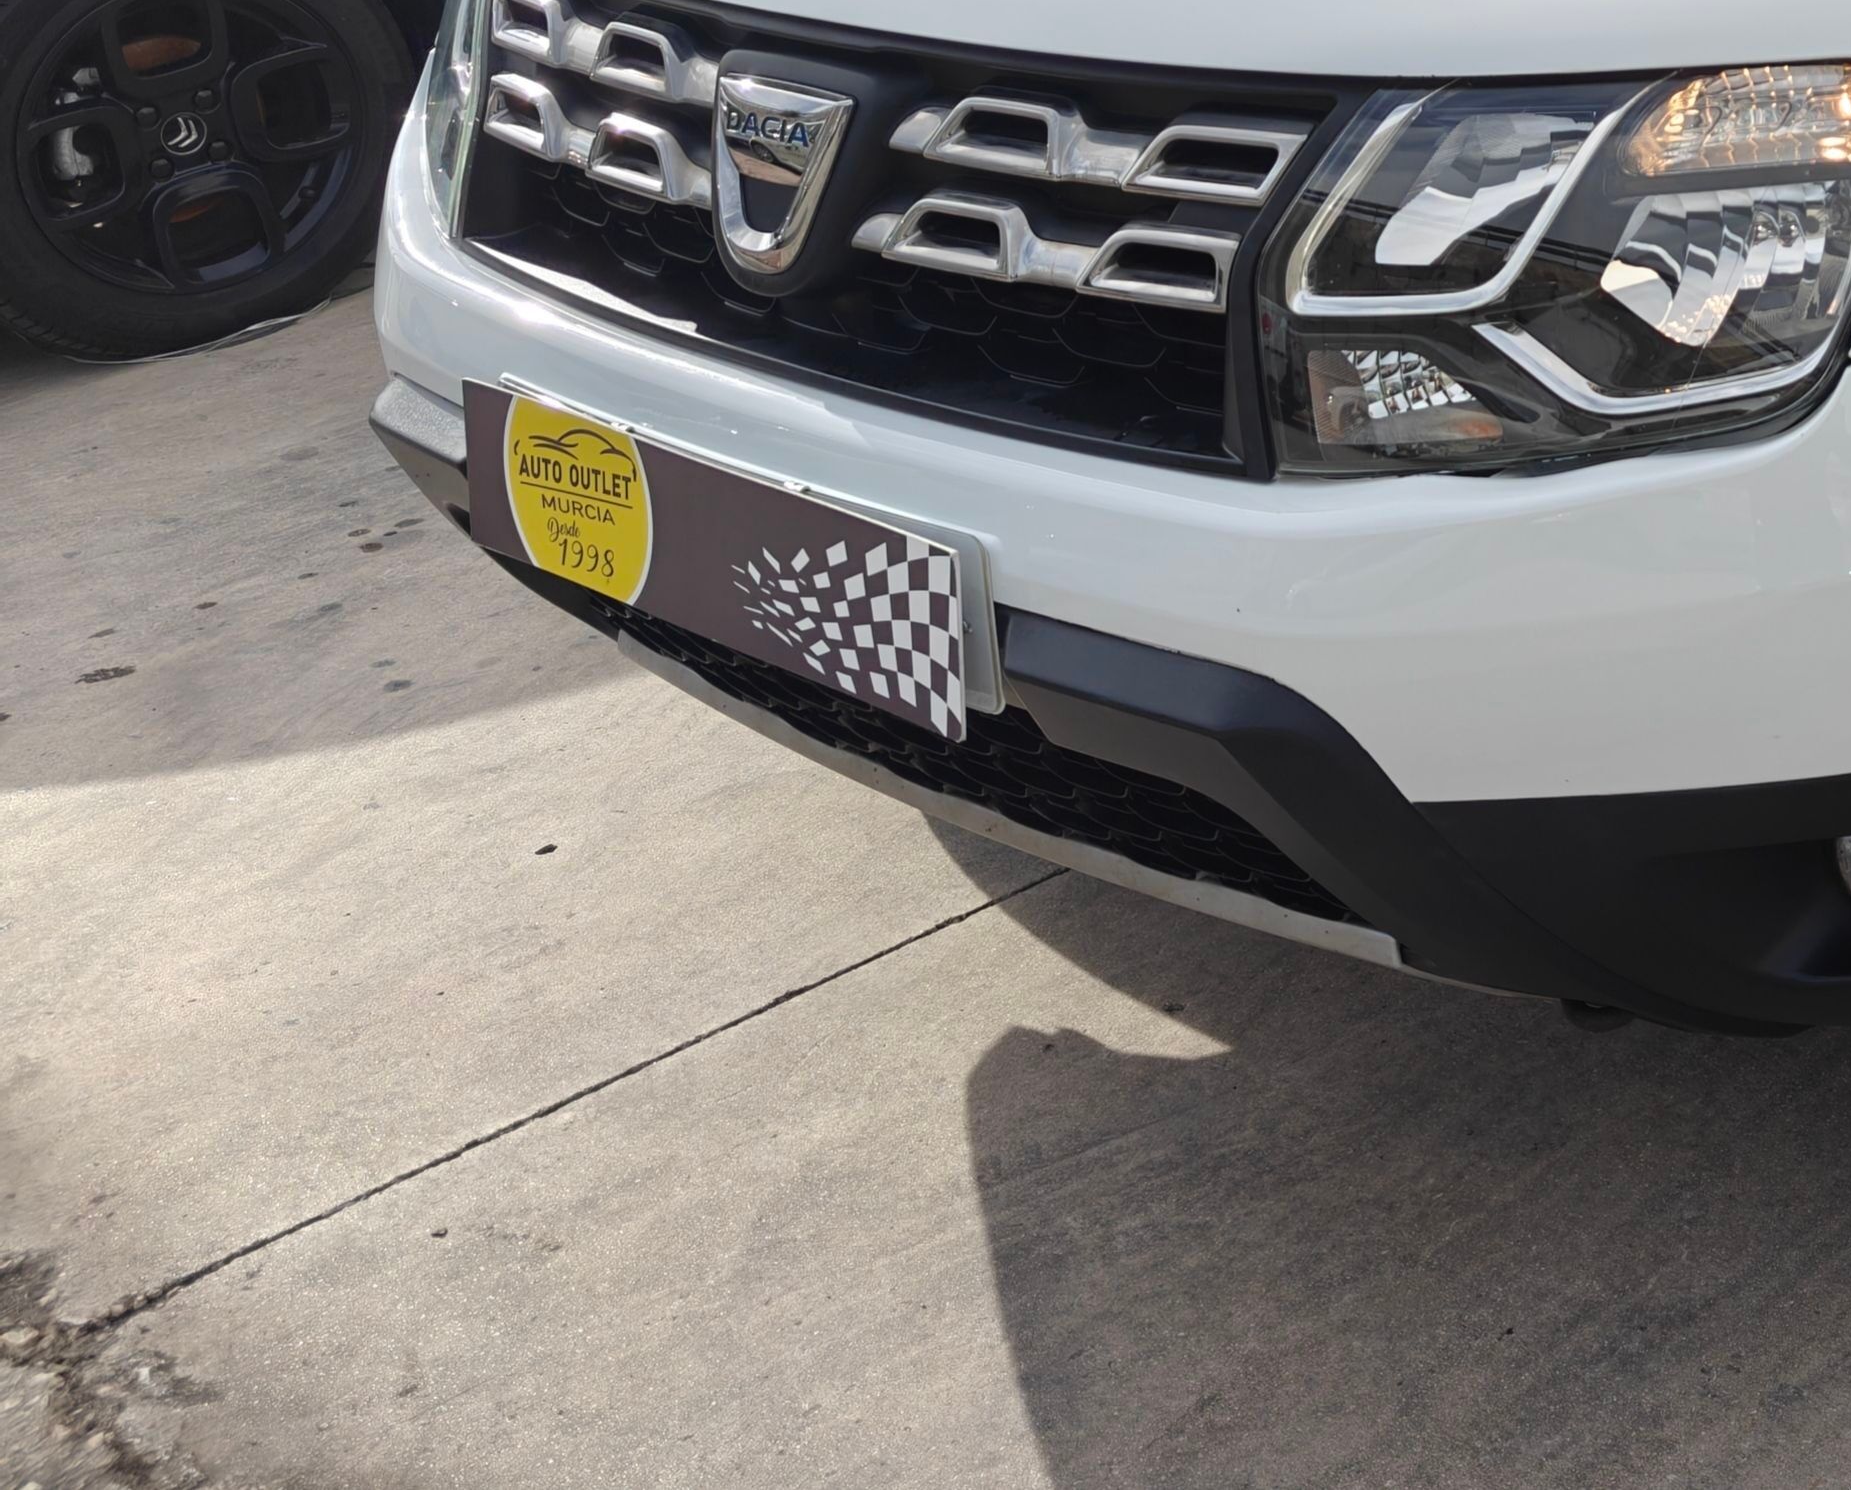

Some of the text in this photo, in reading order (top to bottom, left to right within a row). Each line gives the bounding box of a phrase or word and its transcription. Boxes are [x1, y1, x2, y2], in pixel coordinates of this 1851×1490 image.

[726, 102, 809, 148] DACIA
[519, 453, 632, 500] AUTO OUTLET
[541, 493, 616, 526] MURCIA
[547, 516, 581, 542] Desde
[559, 538, 615, 578] 1998
